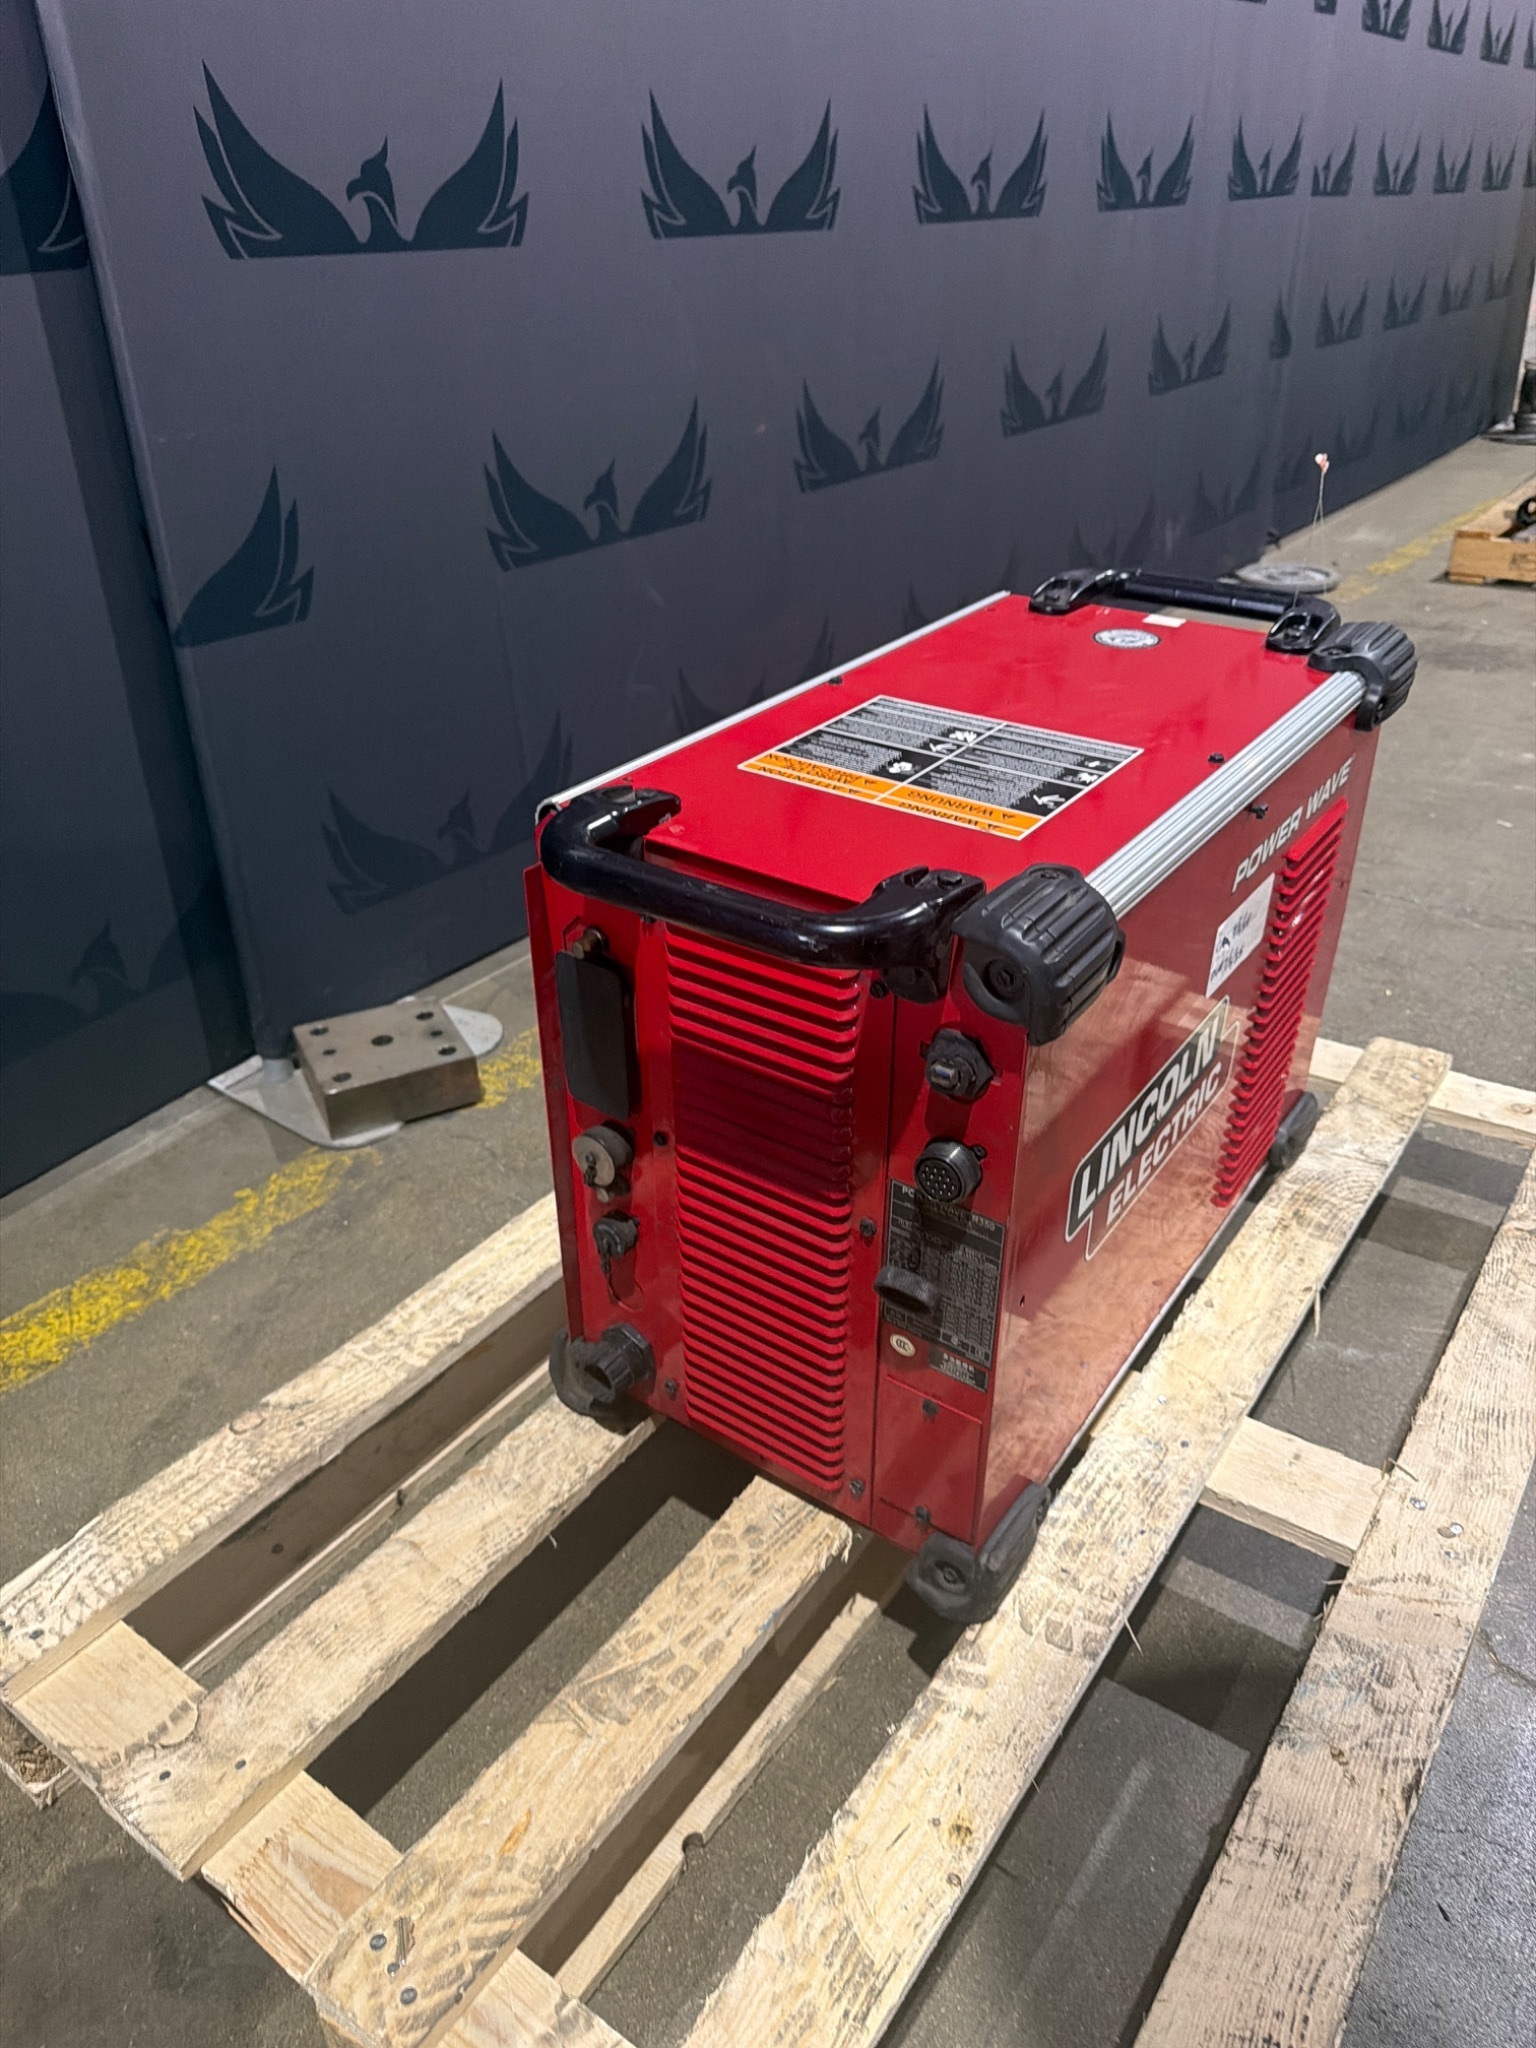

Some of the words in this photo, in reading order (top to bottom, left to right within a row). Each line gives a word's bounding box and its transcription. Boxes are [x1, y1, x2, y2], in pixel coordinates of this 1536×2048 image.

[898, 801, 979, 827] WARNING
[907, 789, 994, 817] WARNUNG
[1231, 805, 1304, 894] POWER
[1305, 757, 1352, 820] WAVE
[1077, 1015, 1220, 1220] LINCOLN
[1106, 1061, 1222, 1227] ELECTRIC
